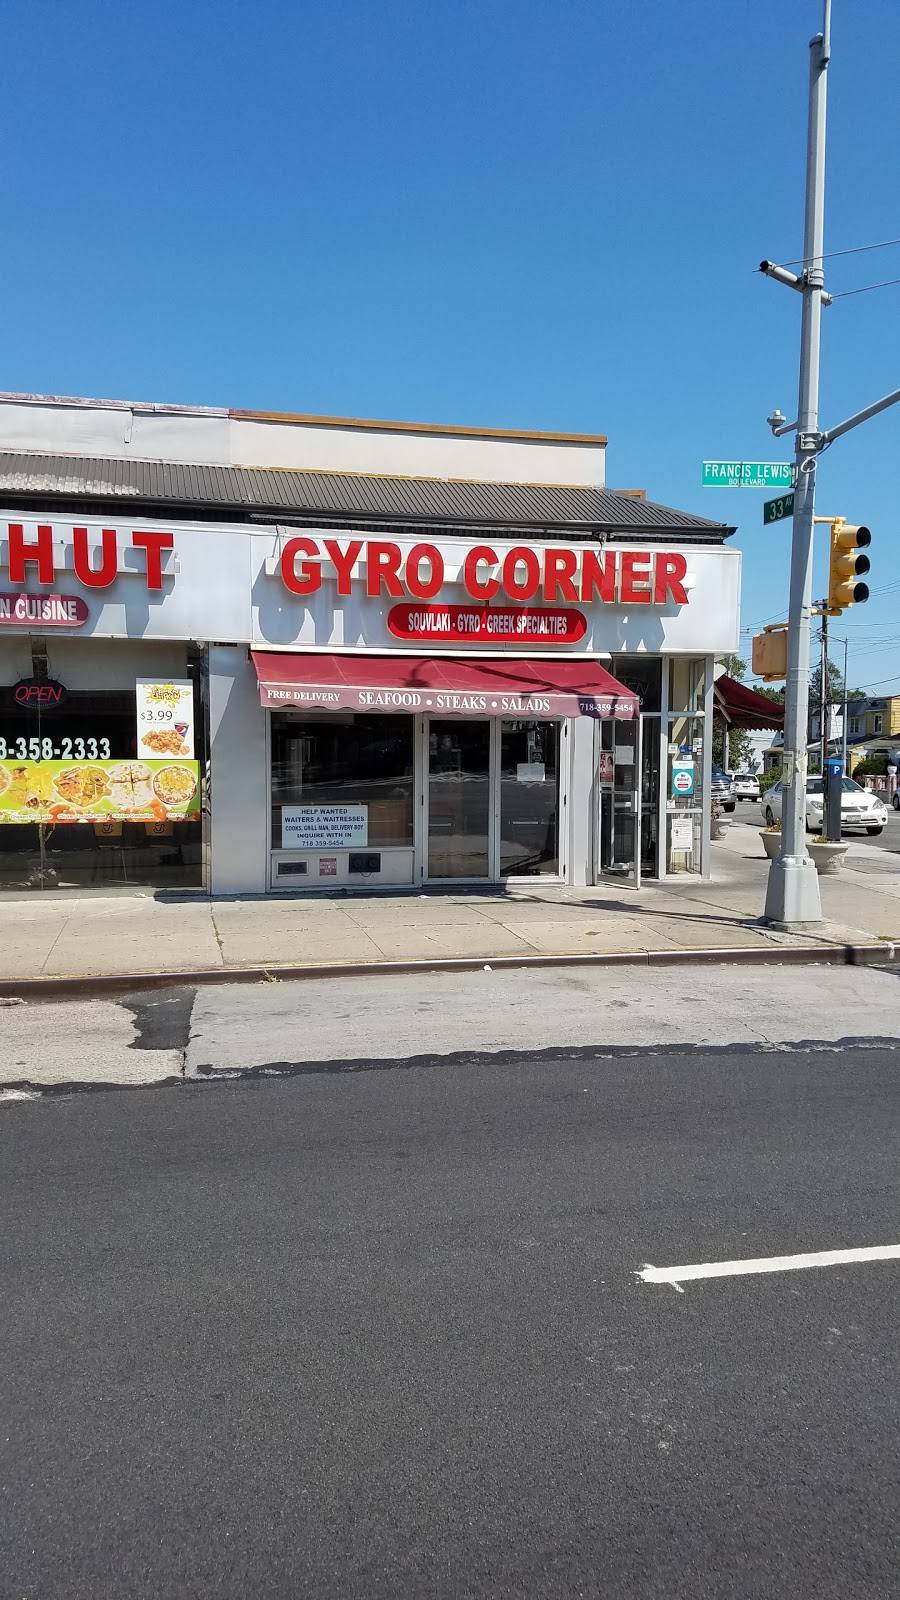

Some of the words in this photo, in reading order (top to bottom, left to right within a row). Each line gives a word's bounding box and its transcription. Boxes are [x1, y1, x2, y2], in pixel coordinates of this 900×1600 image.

[705, 464, 751, 478] FRANCIS
[757, 465, 789, 478] LEWIS
[728, 478, 766, 486] BOULEVARD
[769, 501, 784, 520] 33
[8, 523, 174, 590] HUT
[281, 537, 445, 599] GYRO
[464, 546, 689, 605] CORNER
[15, 598, 77, 620] CUISINE
[408, 612, 451, 633] SOUVLAKI
[457, 614, 480, 634] GYRO
[487, 615, 514, 634] GREEK
[516, 614, 567, 635] SPECIALTIES
[15, 686, 63, 703] OPEN
[267, 690, 291, 701] FREE
[294, 691, 340, 703] DELIVERY
[358, 692, 421, 707] SEAFOOD
[436, 694, 486, 710] STEAKS
[501, 695, 550, 712] SALADS
[140, 710, 173, 721] $3.99
[579, 701, 634, 713] 718-359-5454
[834, 766, 840, 775] P
